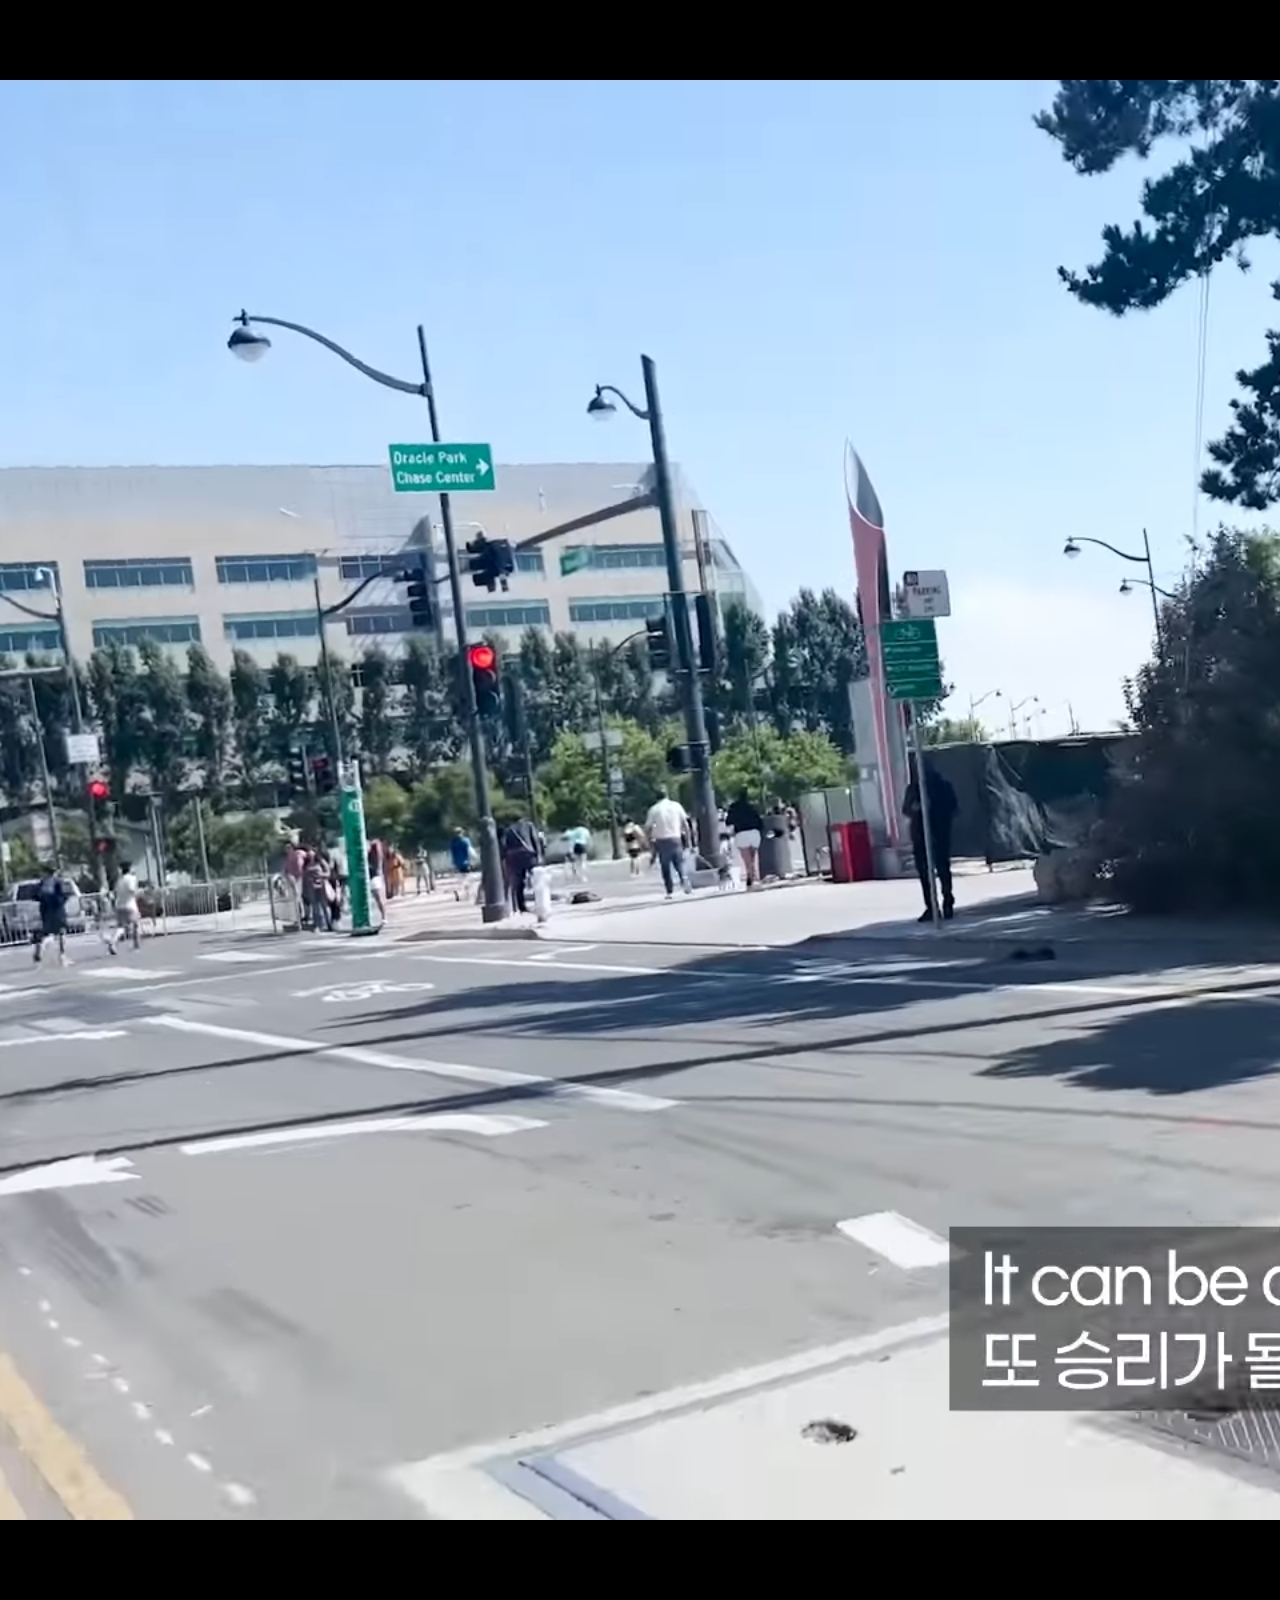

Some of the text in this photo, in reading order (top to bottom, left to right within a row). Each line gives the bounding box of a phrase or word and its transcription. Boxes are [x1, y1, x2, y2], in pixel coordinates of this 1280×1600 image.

[393, 451, 467, 465] Oracle Park
[396, 471, 475, 484] Chase Center
